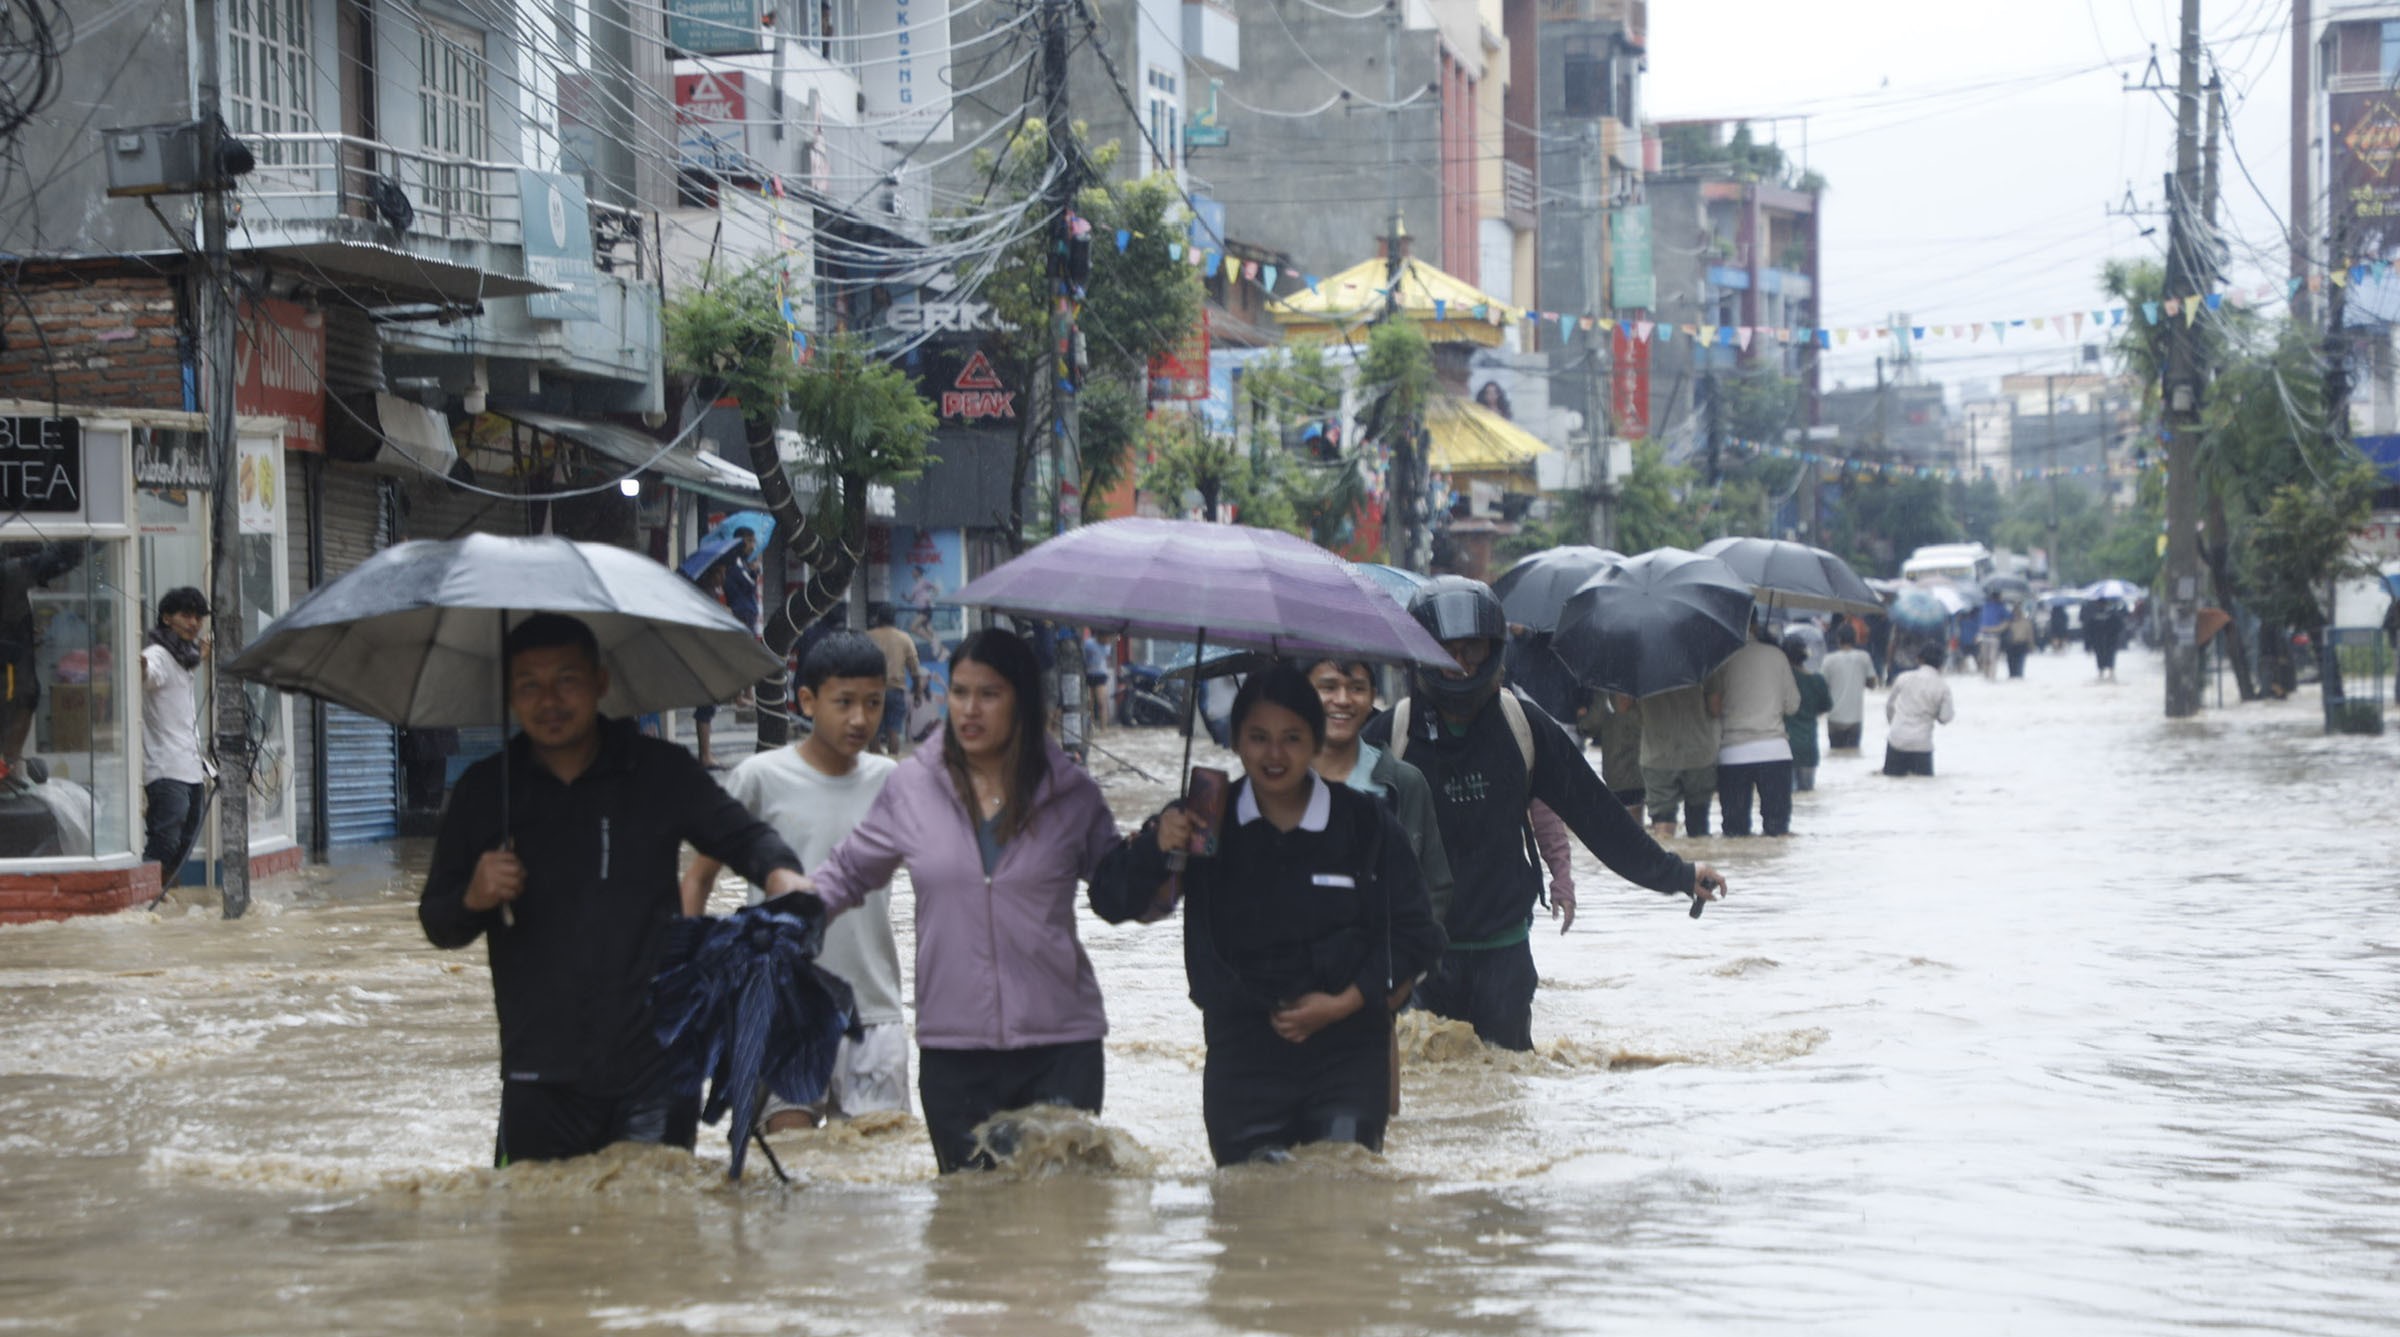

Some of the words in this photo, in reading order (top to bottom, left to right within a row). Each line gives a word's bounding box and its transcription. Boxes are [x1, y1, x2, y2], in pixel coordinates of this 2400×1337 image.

[681, 101, 734, 122] PEAK
[260, 322, 319, 396] CLOTHING
[942, 391, 1016, 417] PEAK
